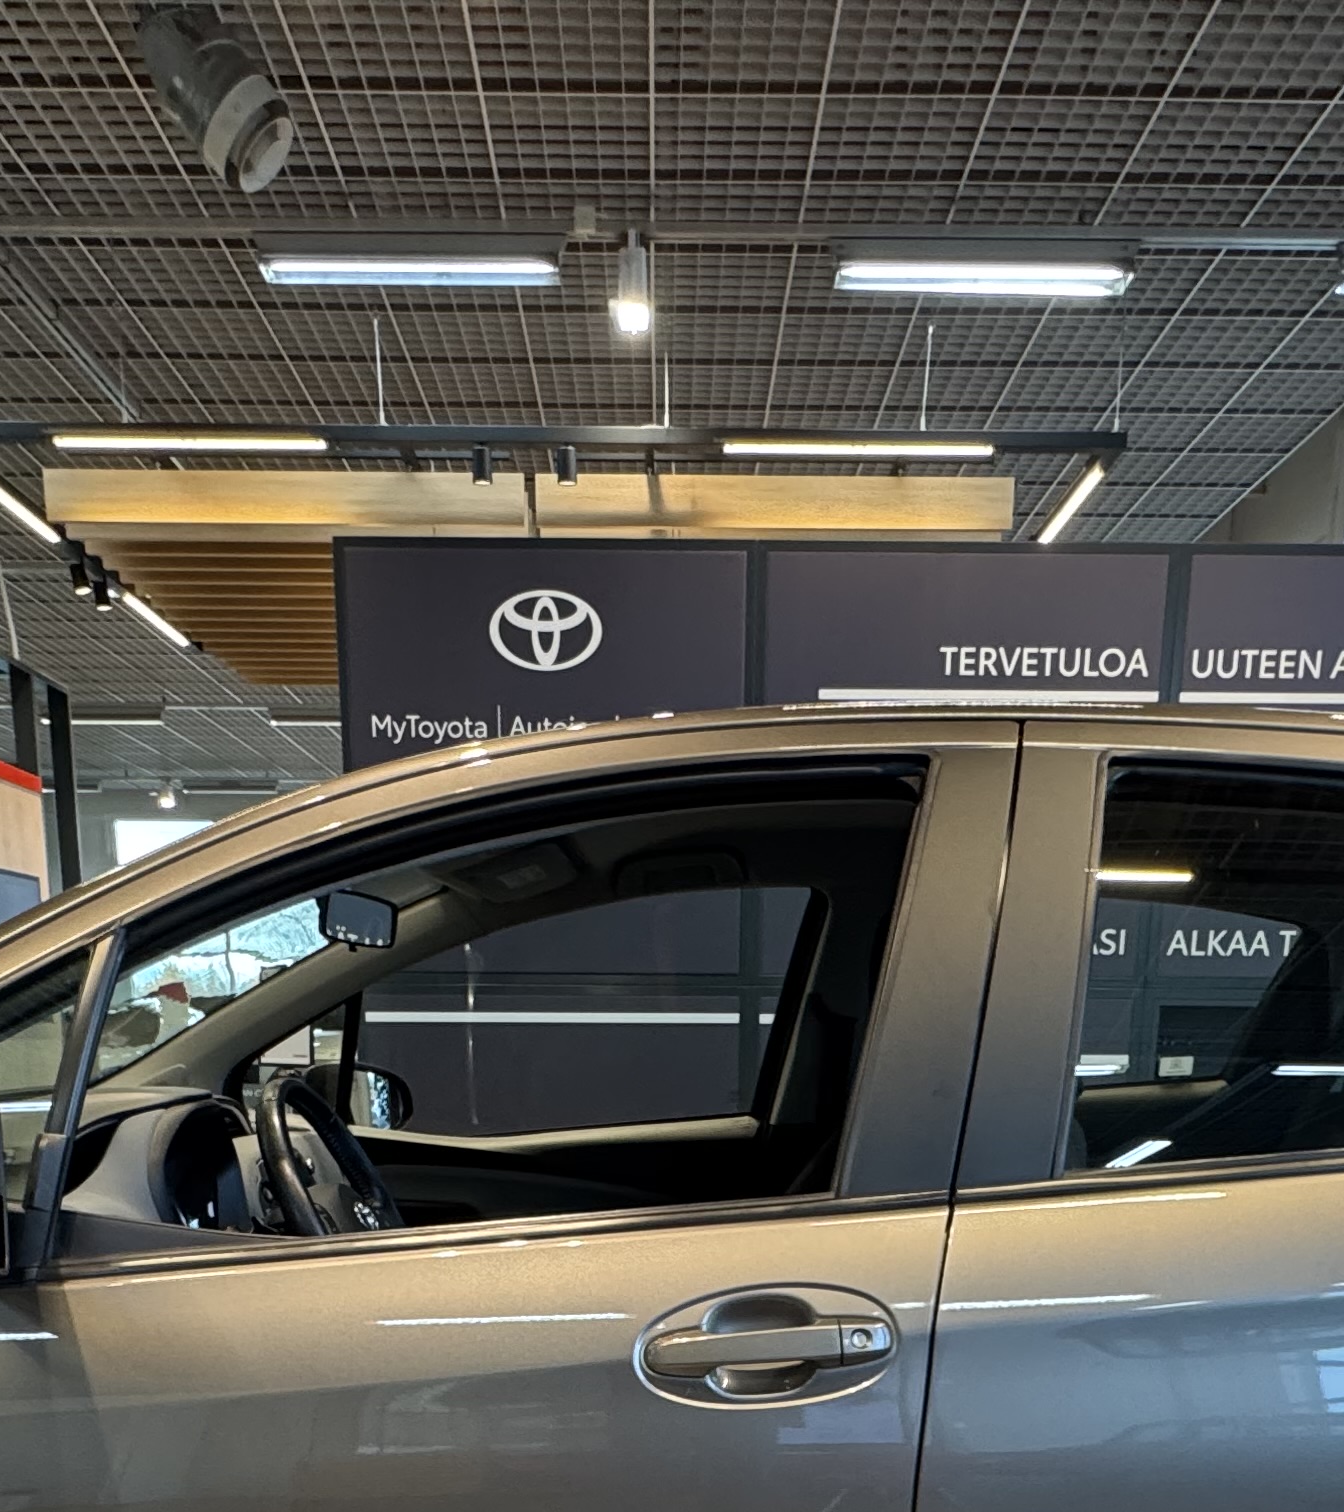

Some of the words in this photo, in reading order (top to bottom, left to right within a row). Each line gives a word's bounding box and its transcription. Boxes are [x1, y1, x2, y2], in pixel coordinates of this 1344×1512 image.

[939, 646, 1149, 678] TERVETULOA
[1191, 648, 1324, 680] UUTEEN
[370, 713, 488, 745] MyToyota
[1166, 929, 1270, 957] ALKAA
